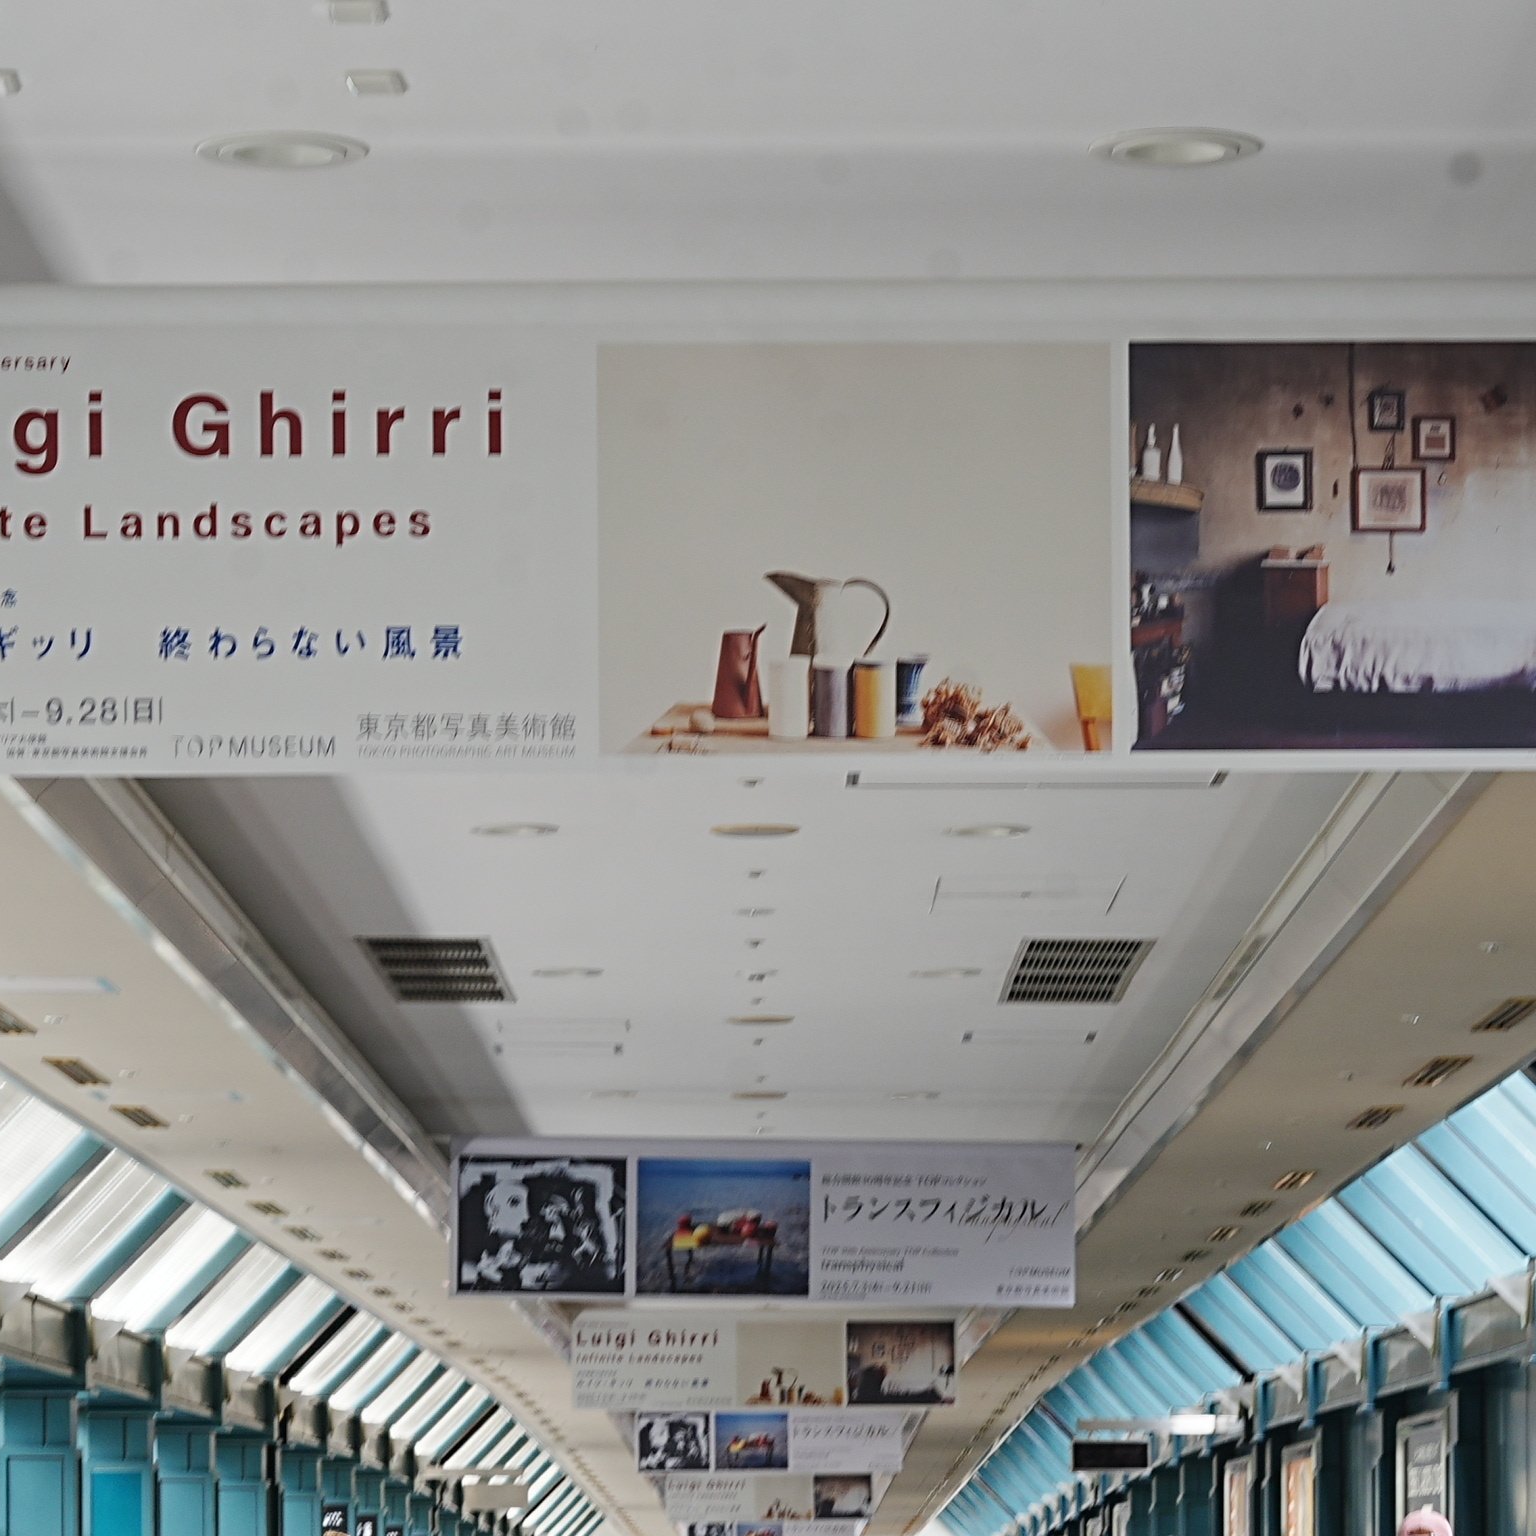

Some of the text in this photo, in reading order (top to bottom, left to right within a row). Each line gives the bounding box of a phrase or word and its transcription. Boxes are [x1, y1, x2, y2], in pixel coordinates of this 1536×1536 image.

[171, 387, 505, 459] Ghirri
[82, 502, 433, 549] Landscapes
[158, 625, 464, 662] 終わらない風景
[356, 710, 577, 742] 東京都写真美術館
[822, 1193, 1049, 1226] トランスフィジカル
[576, 1329, 720, 1350] Luigi Ghirri
